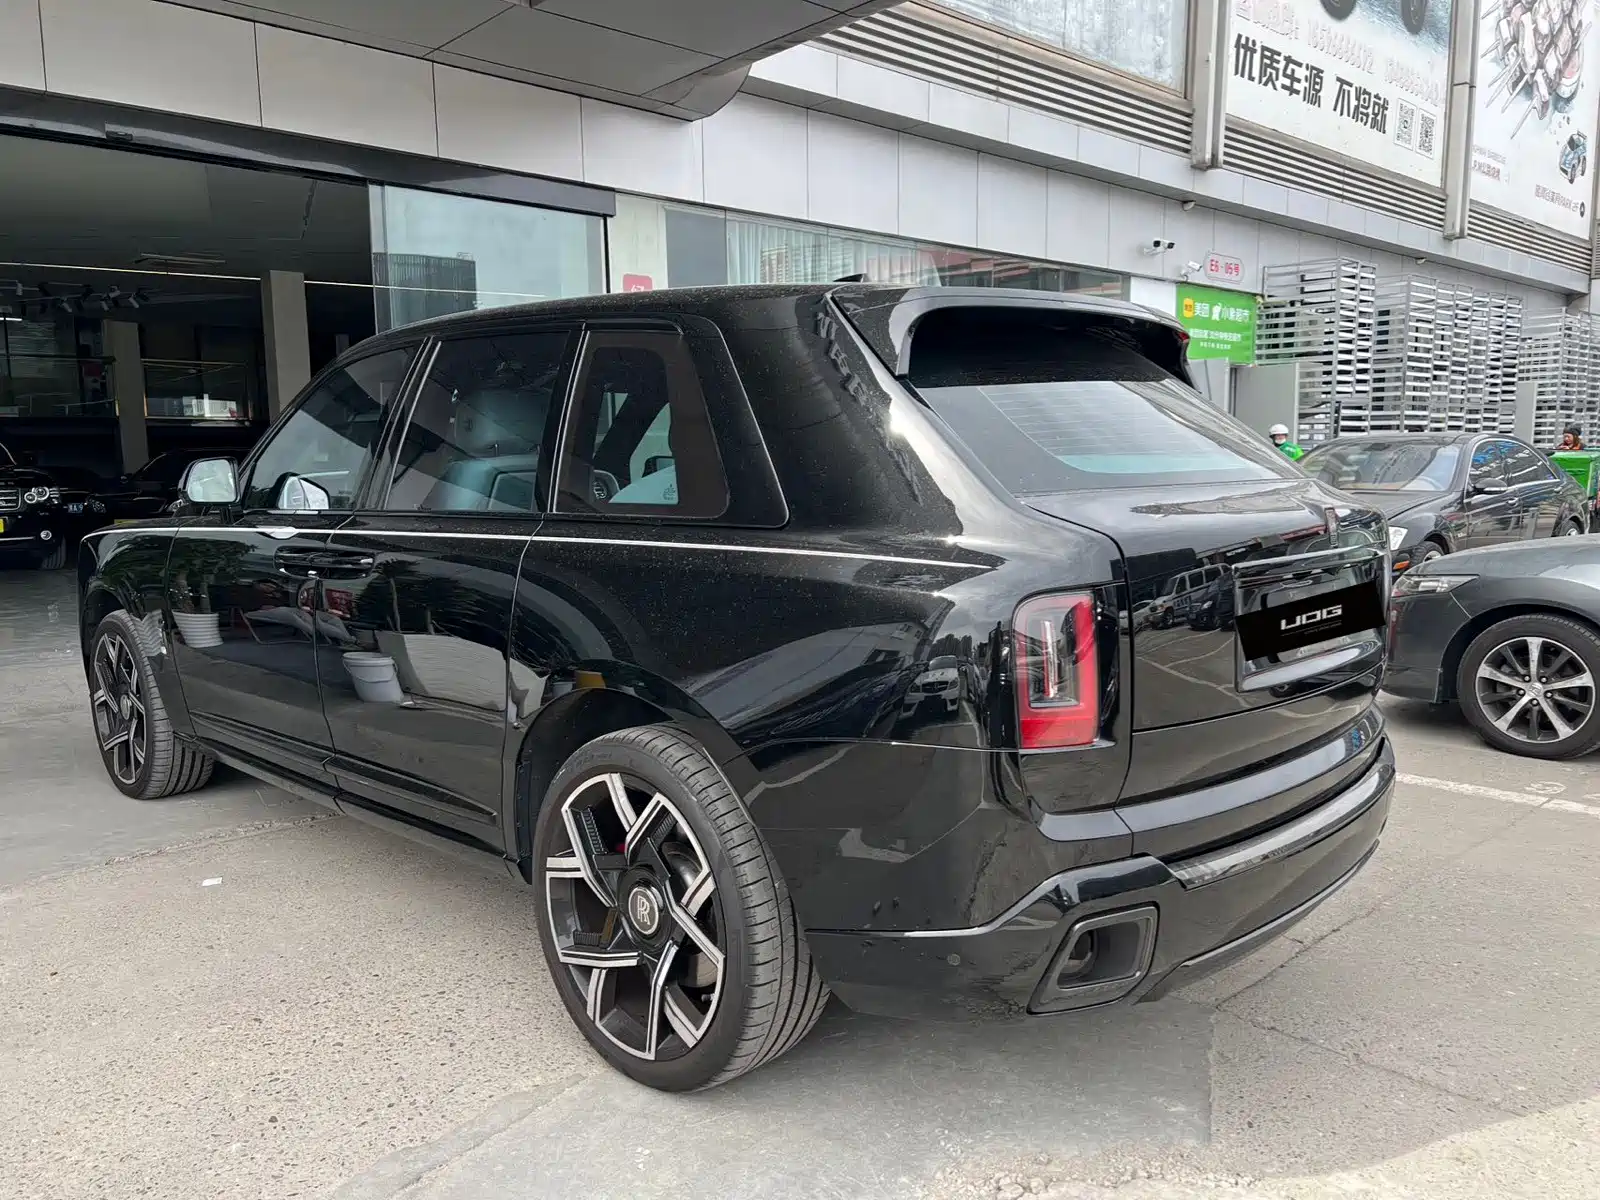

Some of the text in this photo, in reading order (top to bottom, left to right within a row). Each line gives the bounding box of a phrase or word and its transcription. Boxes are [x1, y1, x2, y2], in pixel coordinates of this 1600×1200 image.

[1233, 33, 1324, 108] 优质车源
[1332, 76, 1389, 134] 不将就
